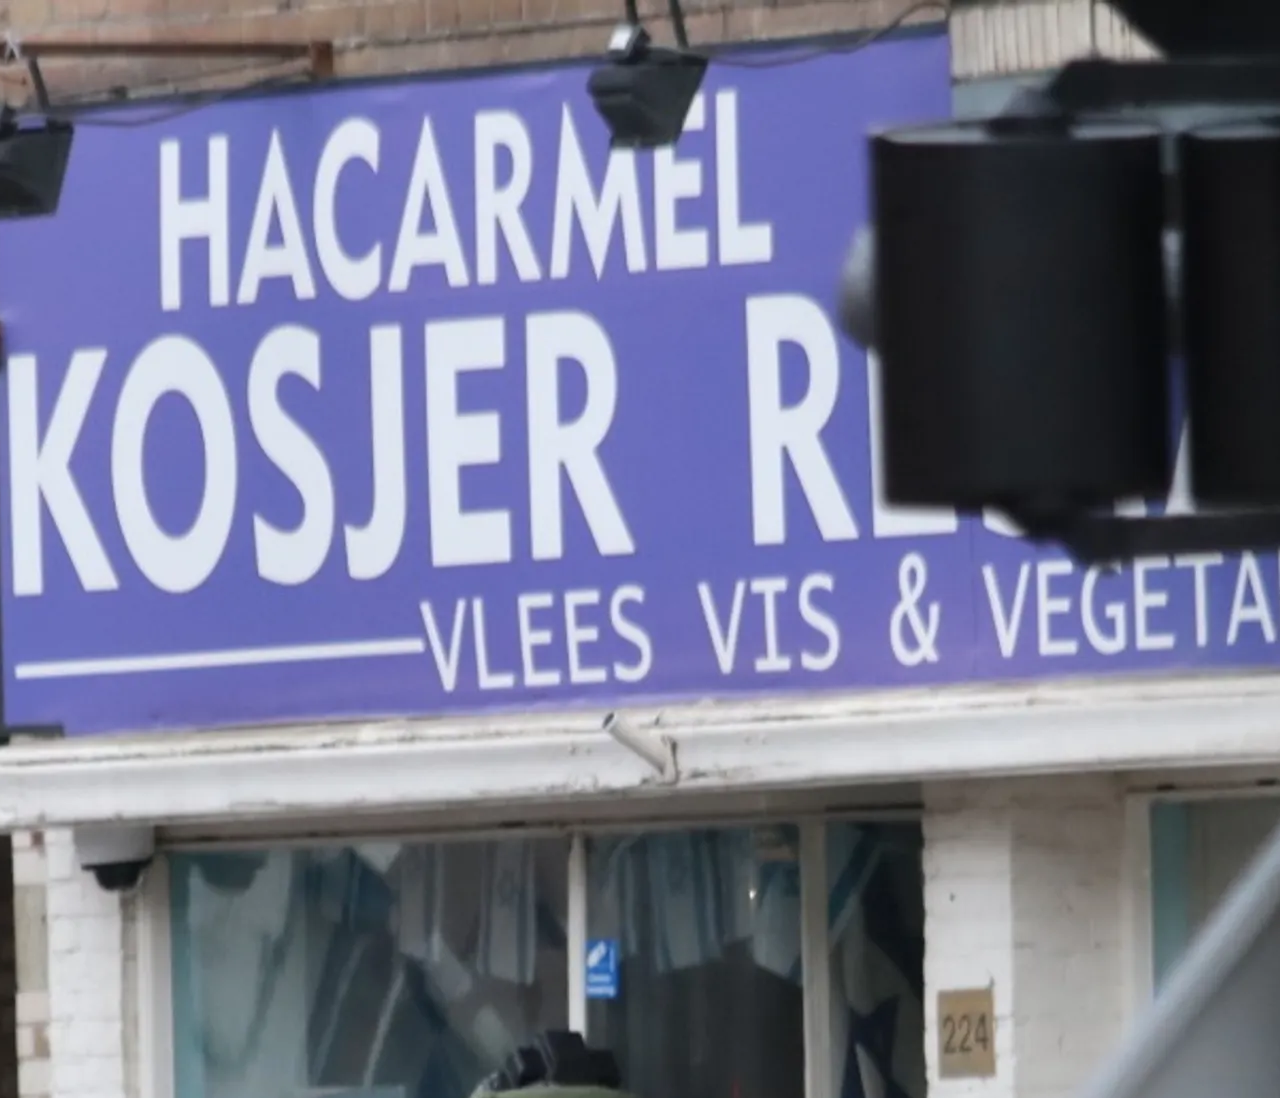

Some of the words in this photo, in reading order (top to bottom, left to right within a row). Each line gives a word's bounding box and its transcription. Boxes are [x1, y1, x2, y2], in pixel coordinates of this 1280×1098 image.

[158, 88, 774, 312] HACARMEL
[6, 309, 636, 597] KOSJER
[419, 583, 653, 693] VLEES
[697, 571, 841, 676] VIS
[889, 550, 942, 667] &
[942, 1013, 989, 1054] 224
